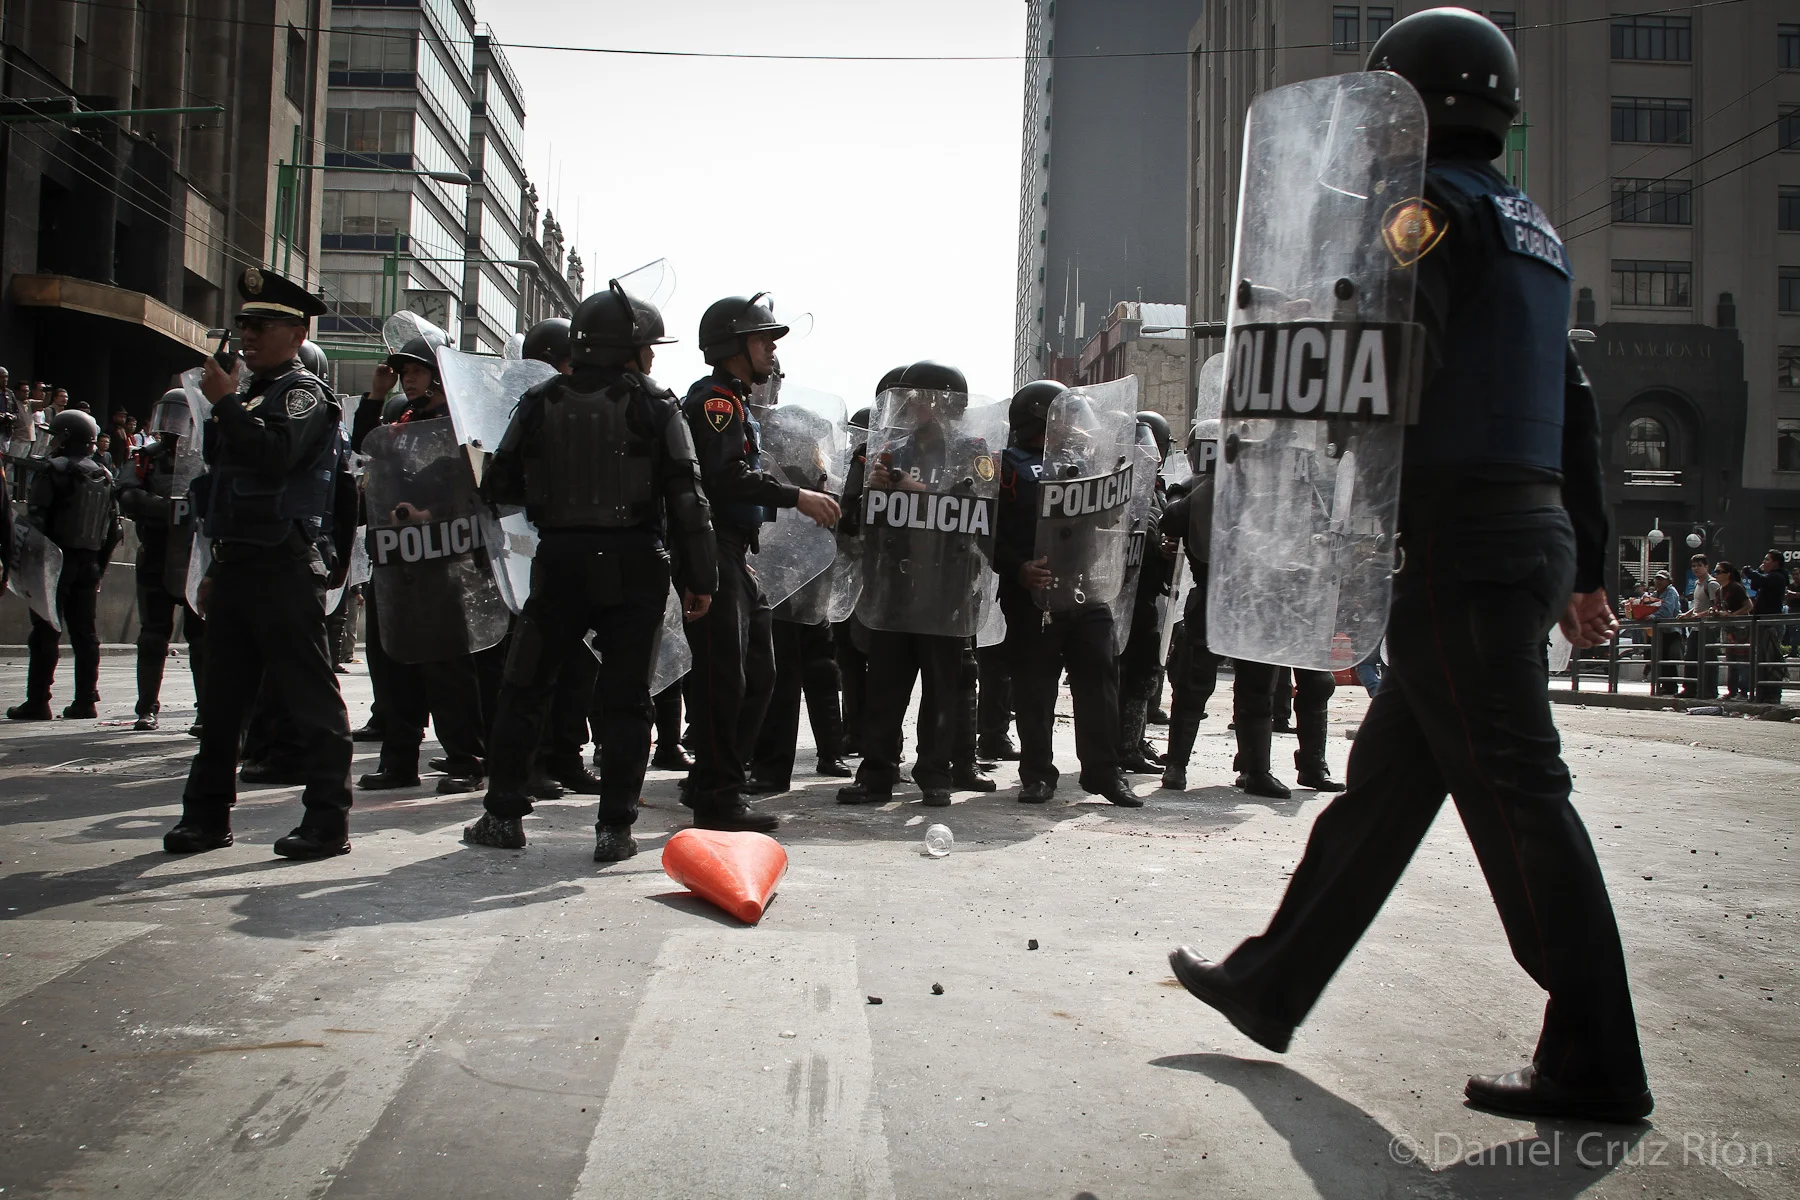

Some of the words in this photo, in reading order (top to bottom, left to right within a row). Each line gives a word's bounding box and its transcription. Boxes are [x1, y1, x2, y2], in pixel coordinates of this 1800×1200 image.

[714, 414, 724, 425] F
[866, 490, 990, 536] POLICIA
[1042, 467, 1132, 518] POLICIA
